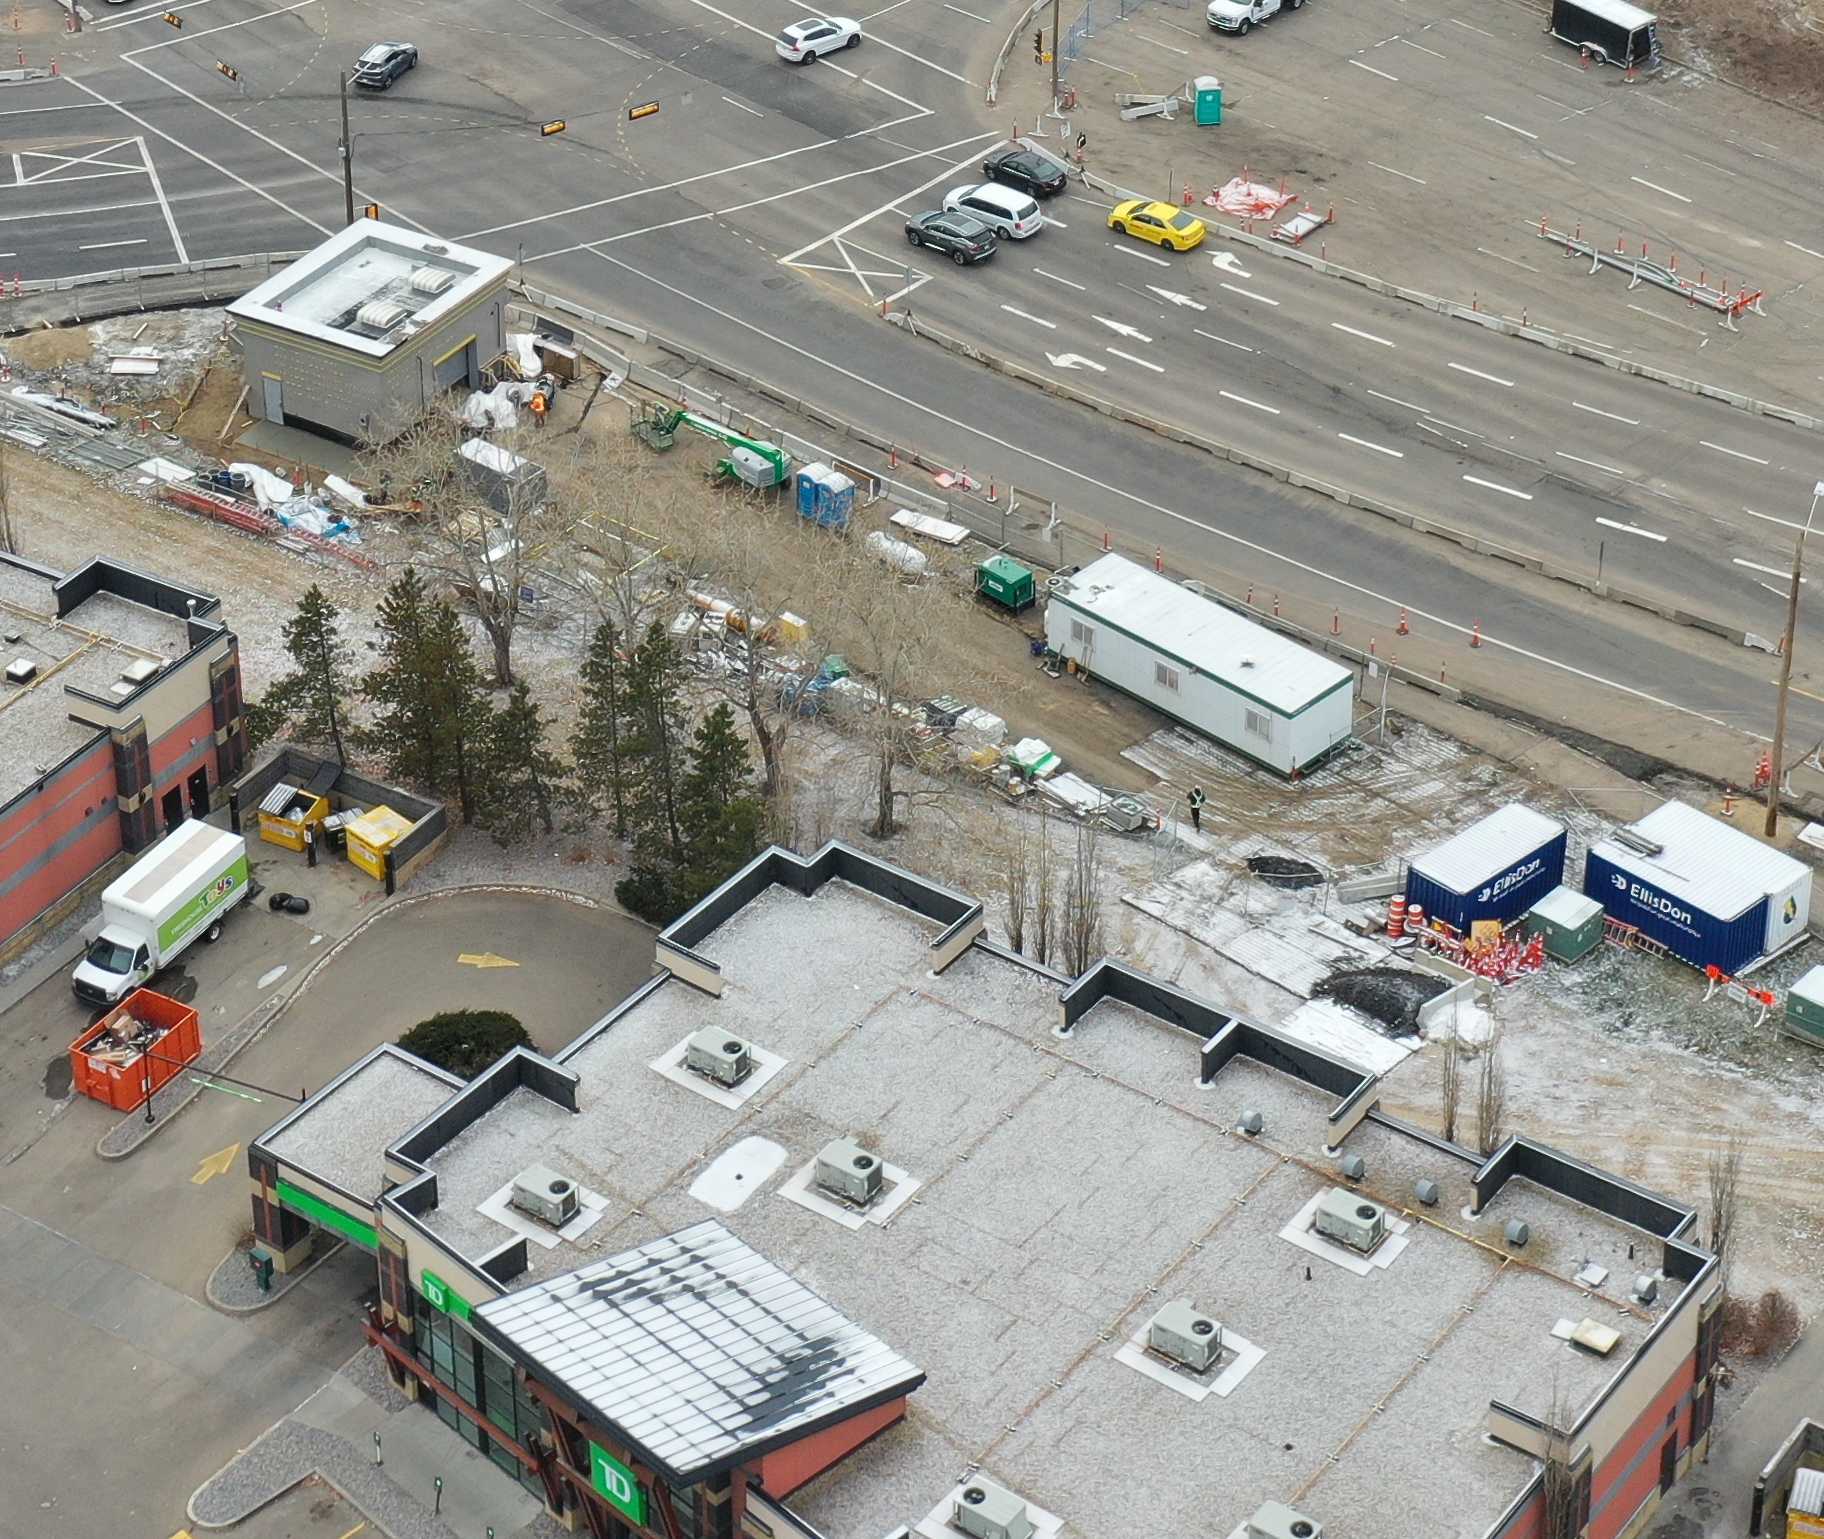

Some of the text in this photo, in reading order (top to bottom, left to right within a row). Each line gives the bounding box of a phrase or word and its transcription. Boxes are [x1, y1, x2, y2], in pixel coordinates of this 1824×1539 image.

[199, 875, 234, 909] Toys
[1492, 858, 1541, 896] EllisDon
[1630, 883, 1692, 925] EllisDon
[424, 1279, 443, 1306] TD
[597, 1458, 631, 1503] TD
